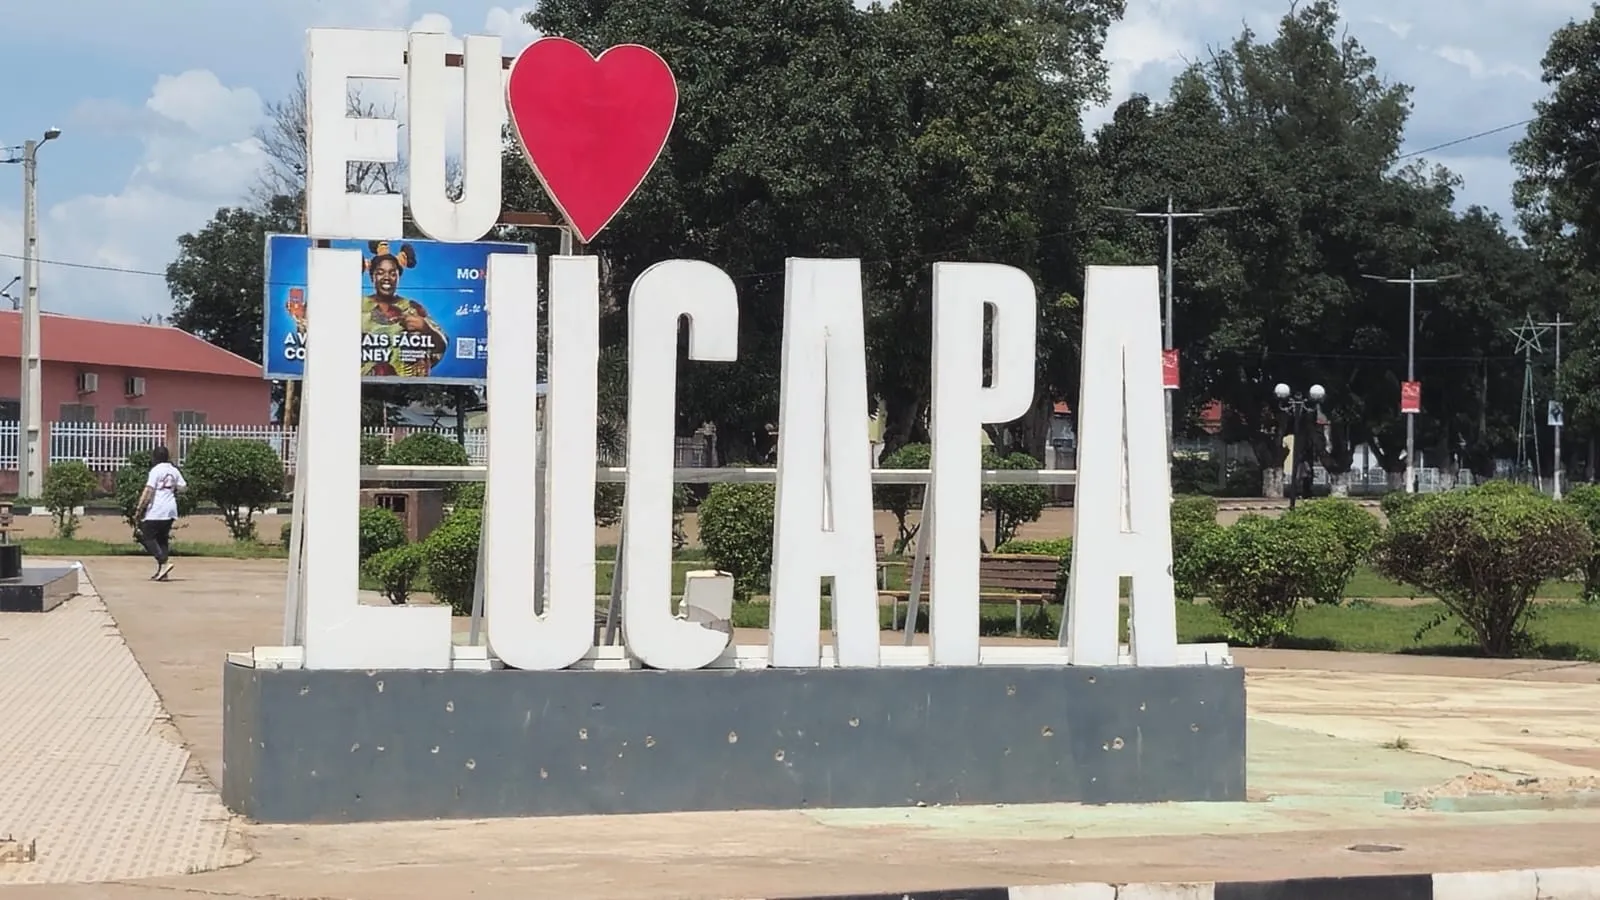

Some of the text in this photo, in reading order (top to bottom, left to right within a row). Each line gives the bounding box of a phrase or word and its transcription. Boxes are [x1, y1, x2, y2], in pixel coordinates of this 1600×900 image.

[307, 28, 502, 243] EU
[284, 332, 296, 345] A
[361, 334, 389, 347] AIS
[392, 331, 435, 348] FÁCIL
[284, 347, 306, 360] CO
[304, 249, 1178, 671] LUCAPA
